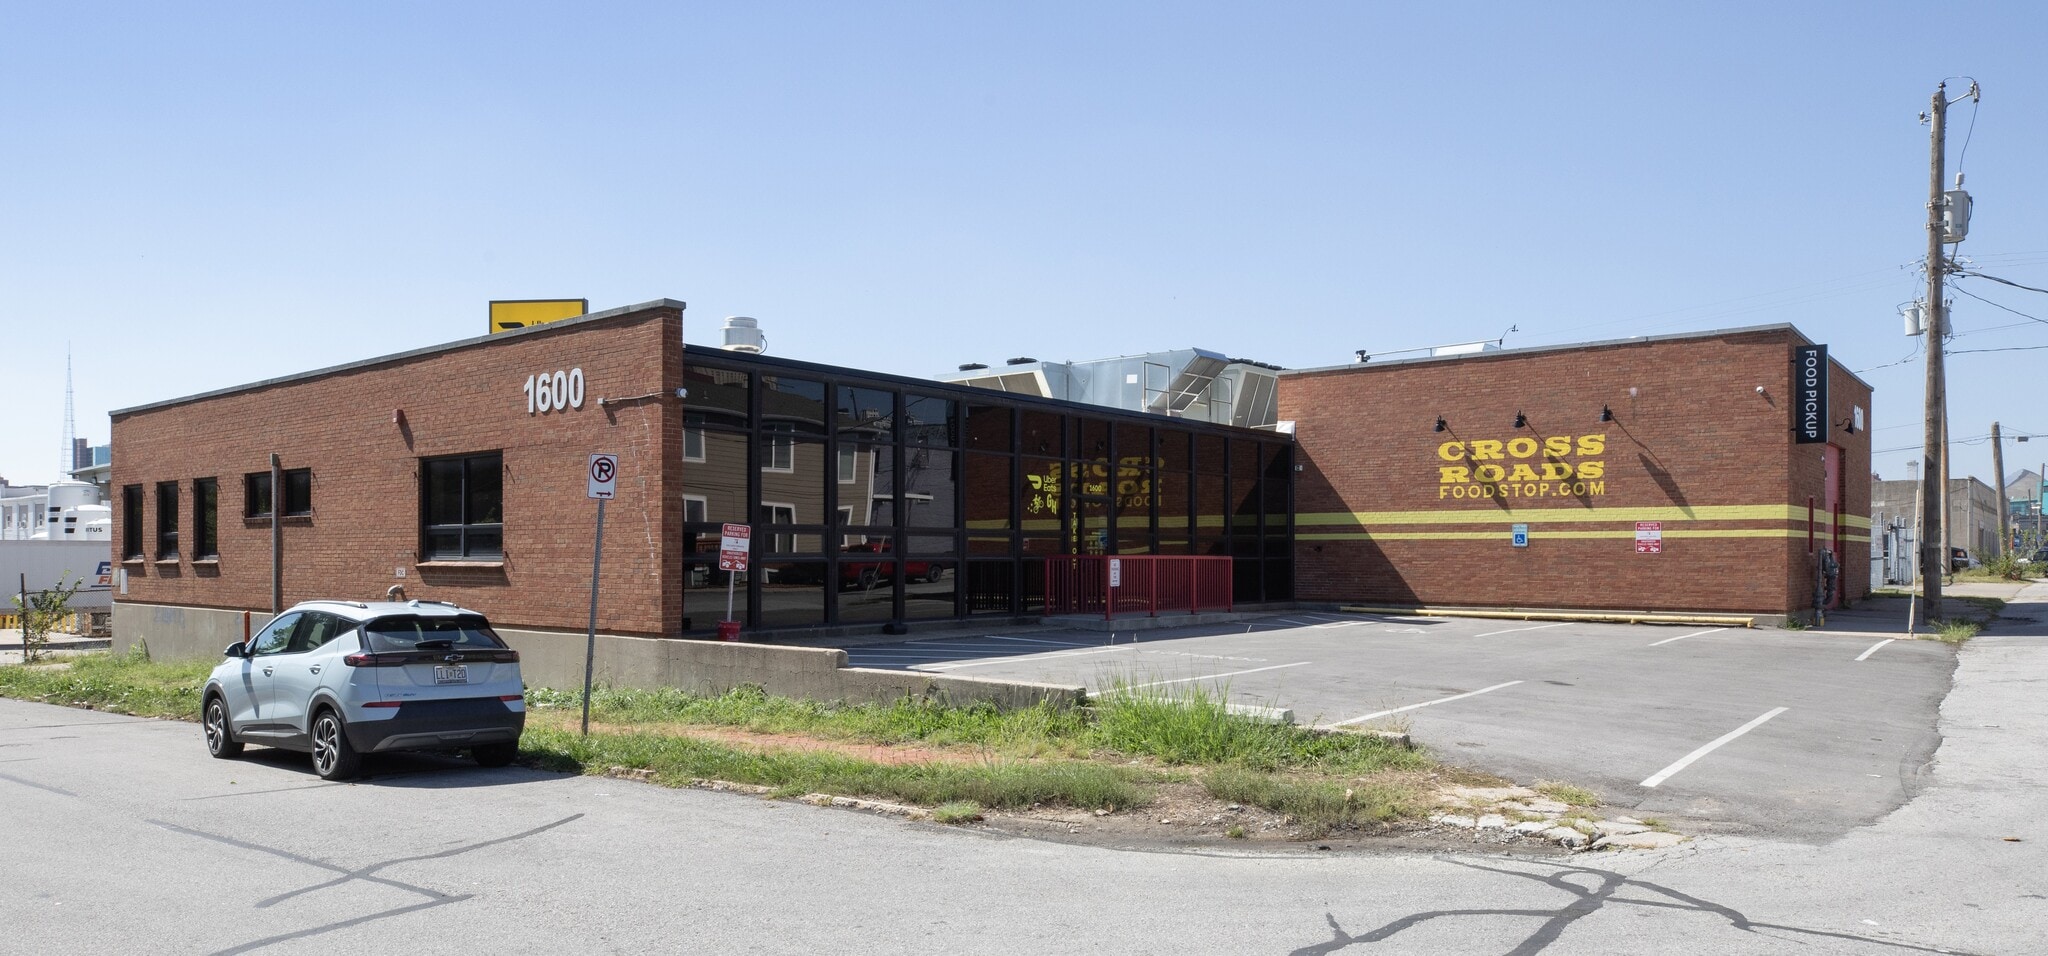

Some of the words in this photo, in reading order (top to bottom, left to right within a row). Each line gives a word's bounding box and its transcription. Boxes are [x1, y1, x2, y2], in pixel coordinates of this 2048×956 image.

[1805, 350, 1817, 387] FOOD
[523, 367, 584, 413] 1600
[1805, 390, 1817, 438] PICKUP
[1438, 434, 1606, 461] CROSS
[1043, 475, 1057, 484] Uber
[1439, 461, 1605, 483] ROADS
[1043, 484, 1057, 492] Eats
[1439, 481, 1605, 500] FOODSTOP.COM
